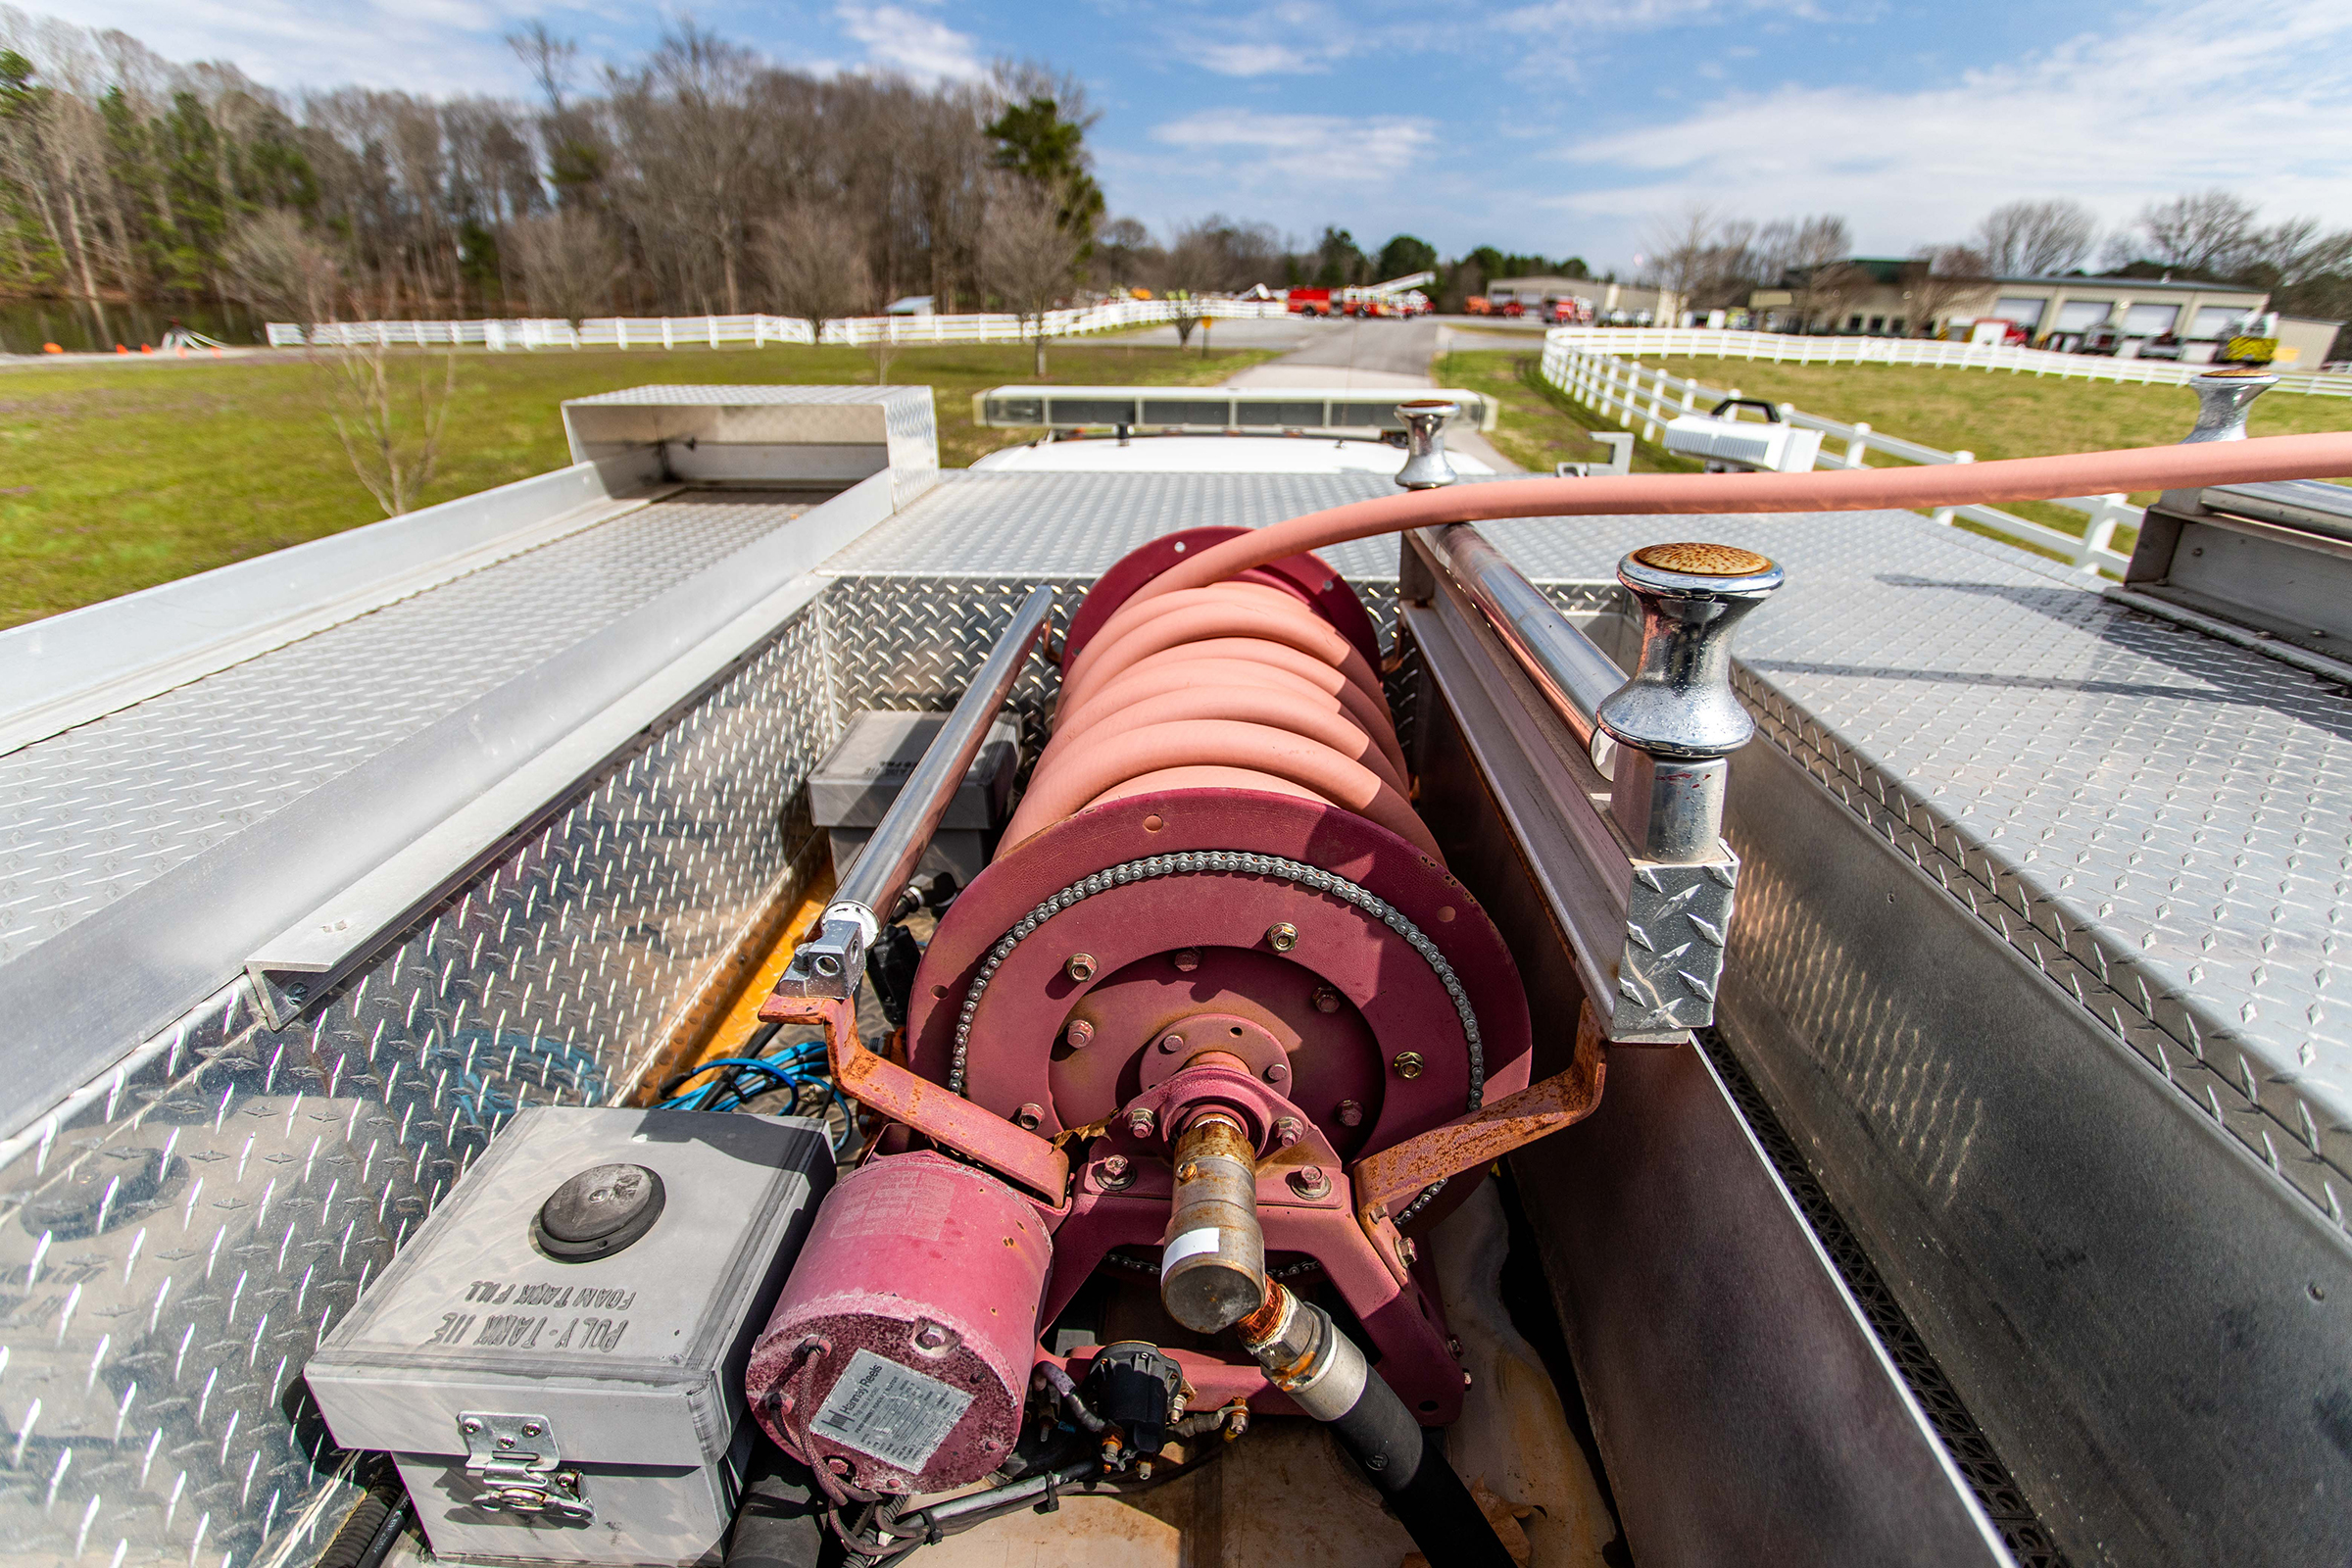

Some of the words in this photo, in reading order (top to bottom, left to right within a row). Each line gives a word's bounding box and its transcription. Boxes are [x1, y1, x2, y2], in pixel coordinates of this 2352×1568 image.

[464, 1280, 516, 1305] FILL
[513, 1282, 574, 1308] TANK
[571, 1287, 637, 1311] FOAM
[839, 1383, 869, 1415] Hannay
[859, 1363, 883, 1388] Reels
